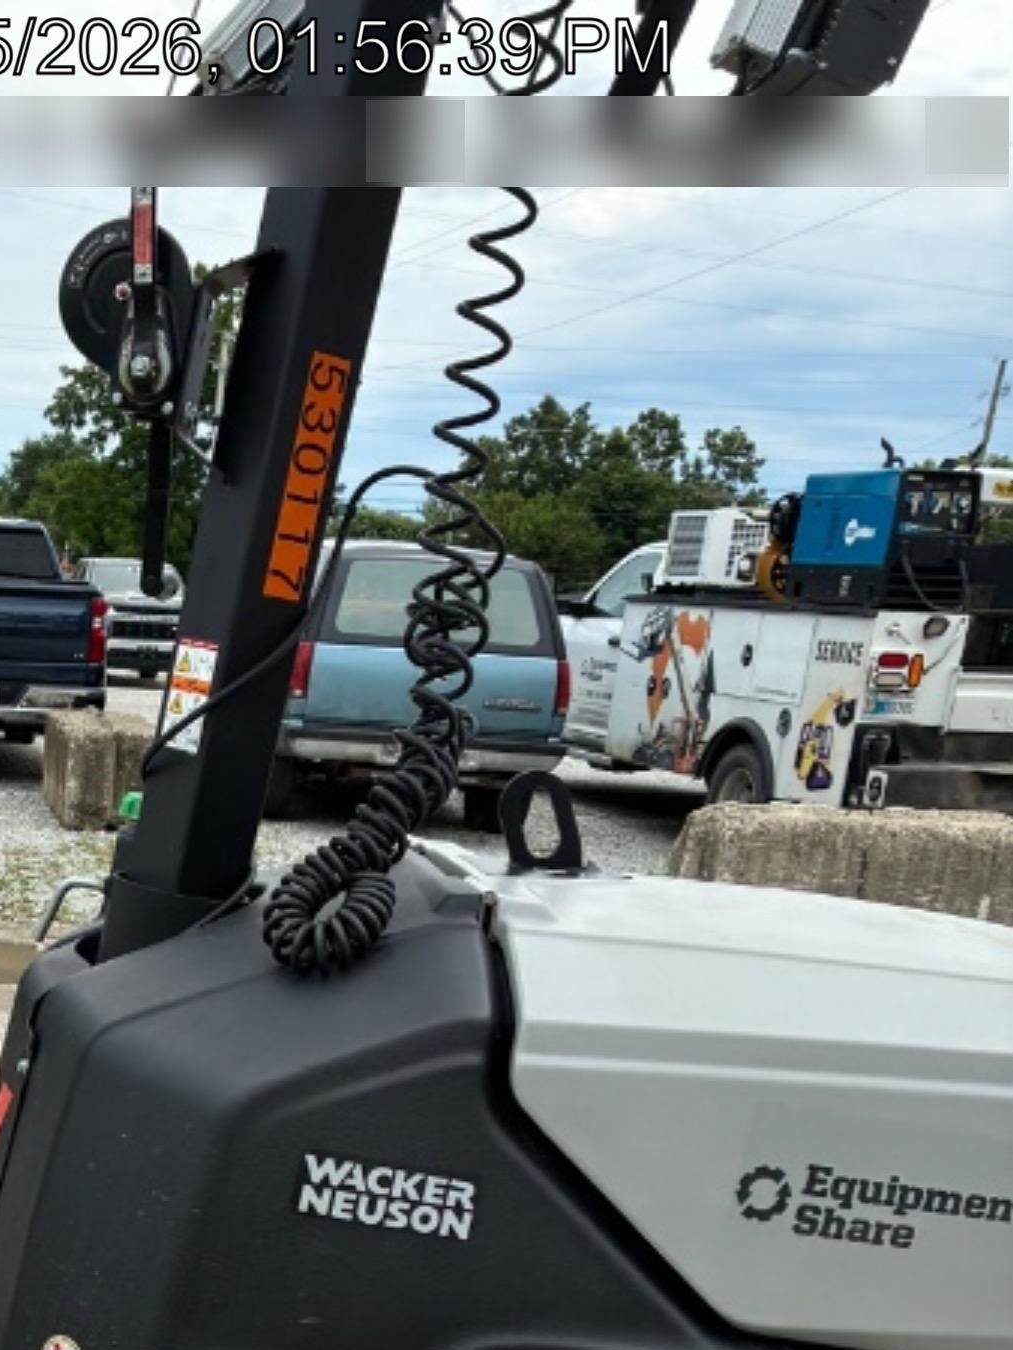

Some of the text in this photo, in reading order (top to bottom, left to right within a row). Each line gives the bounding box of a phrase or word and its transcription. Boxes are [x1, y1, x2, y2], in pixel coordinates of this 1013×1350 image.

[269, 360, 347, 592] 530117
[304, 1153, 476, 1210] WACKER
[298, 1184, 474, 1241] NEUSON
[792, 1203, 916, 1249] Share
